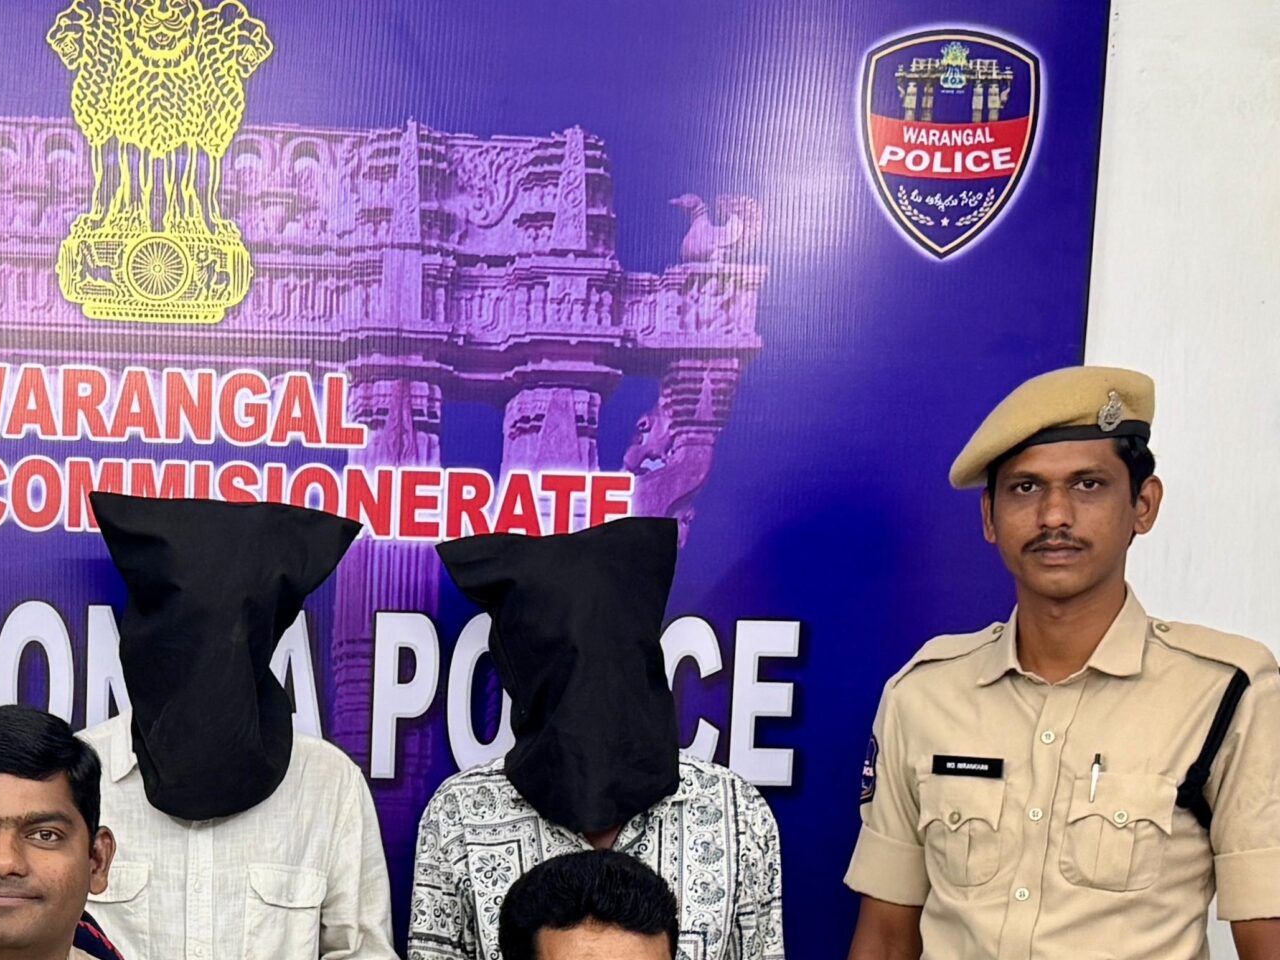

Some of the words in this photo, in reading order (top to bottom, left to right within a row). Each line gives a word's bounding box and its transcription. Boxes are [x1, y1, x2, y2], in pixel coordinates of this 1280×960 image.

[903, 126, 995, 147] WARANGAL
[879, 146, 1016, 173] POLICE
[370, 611, 801, 787] POCE
